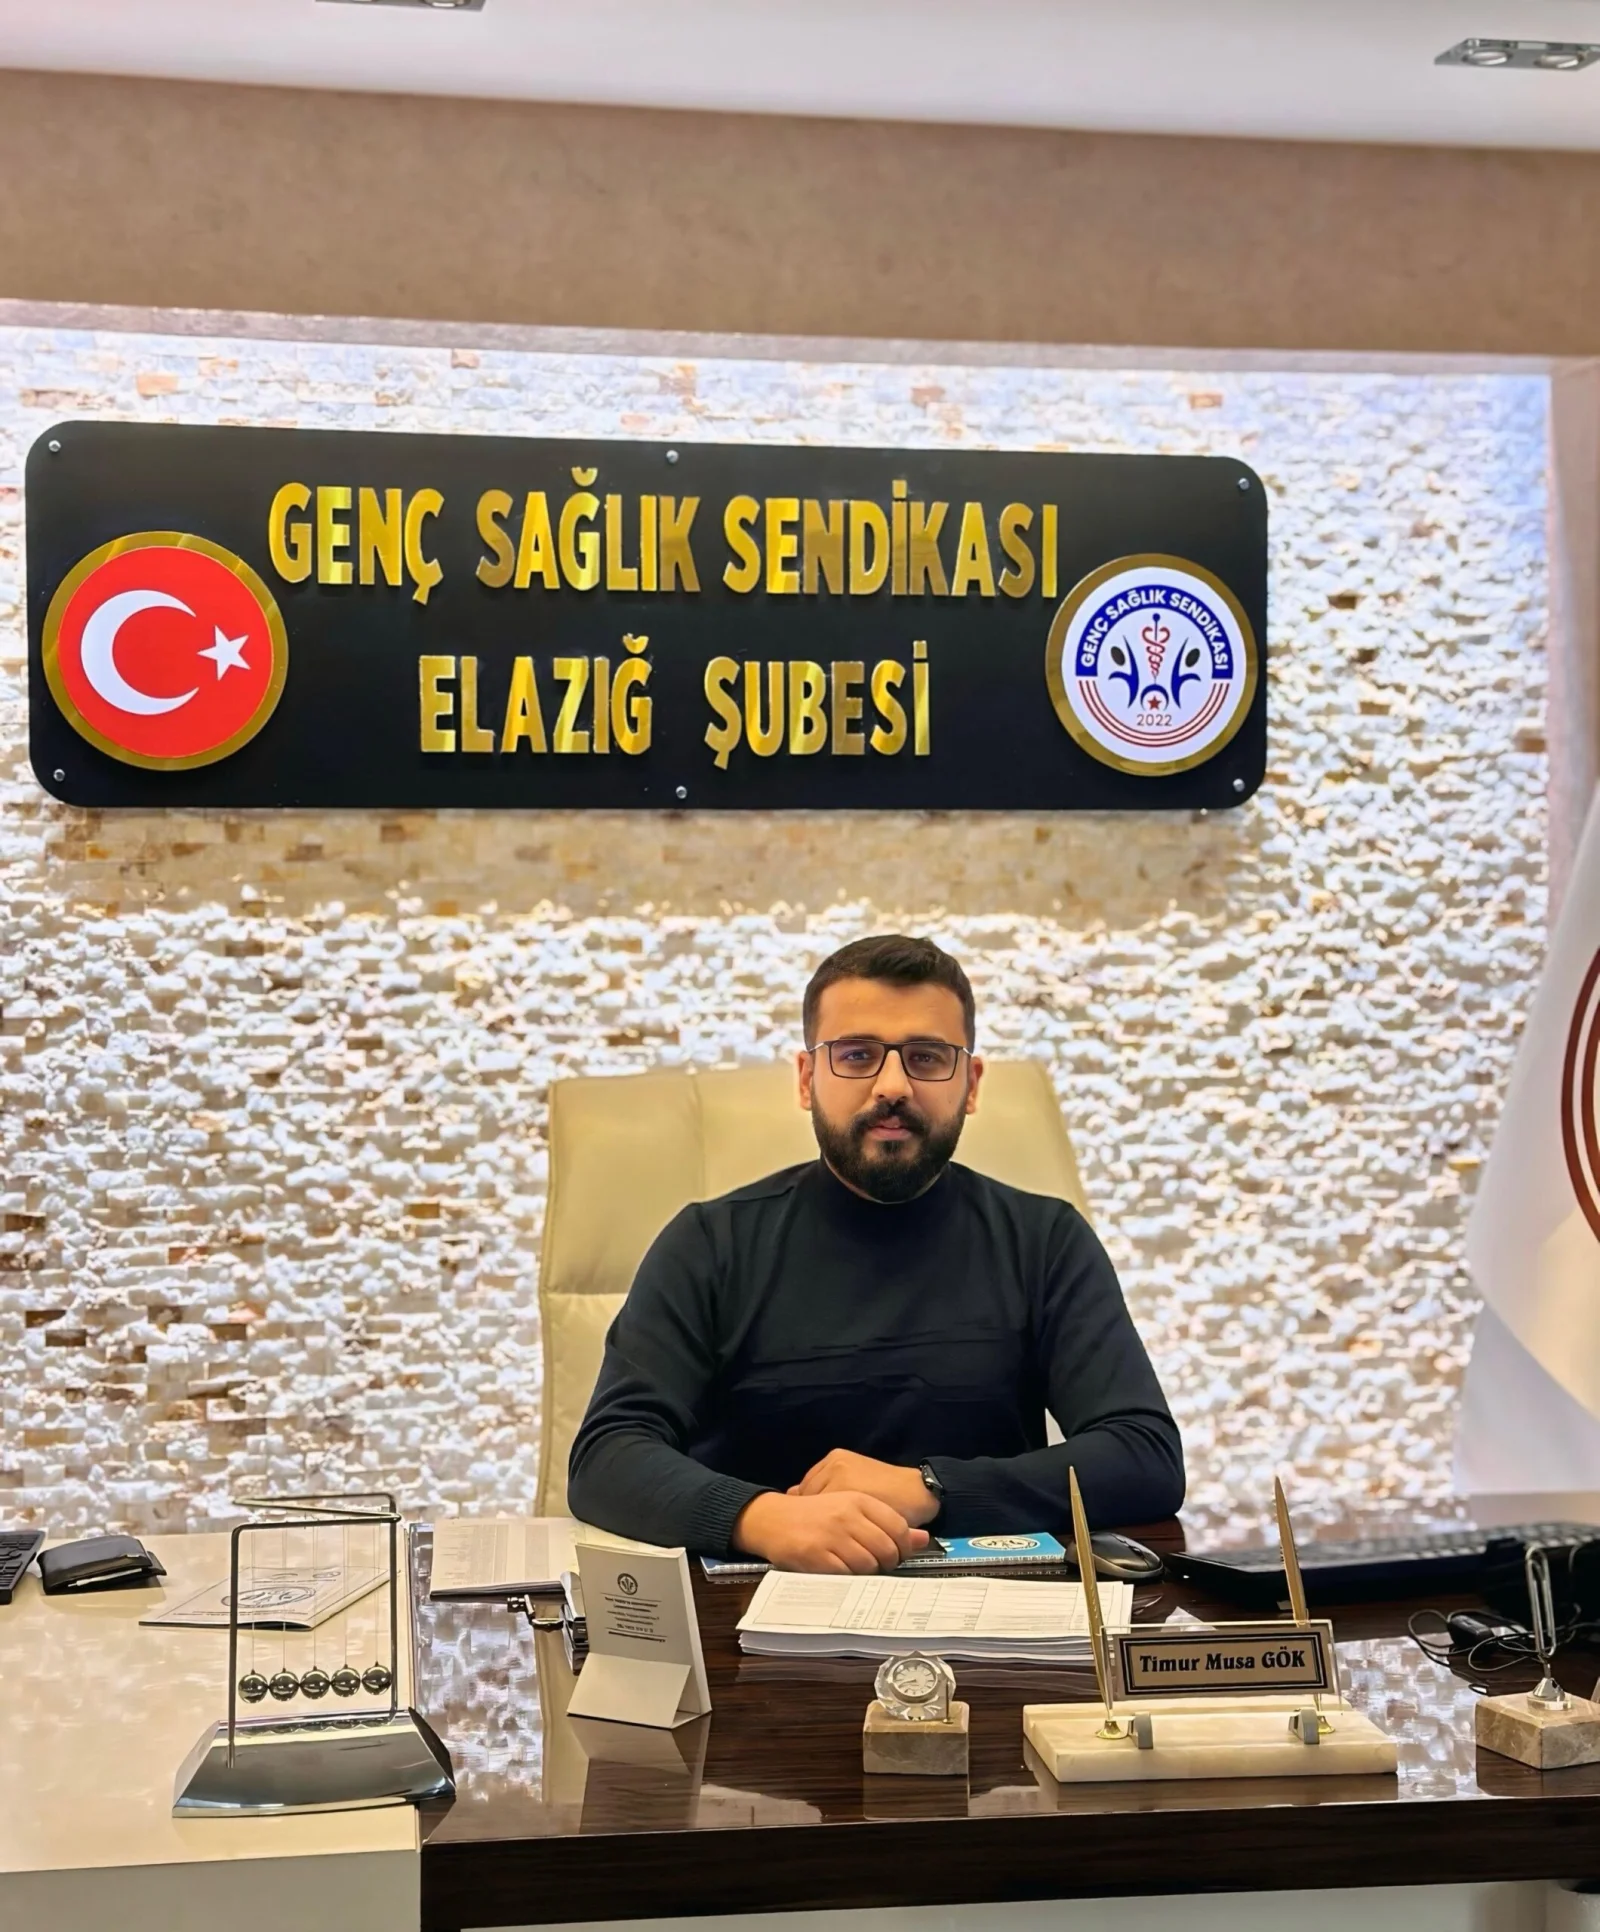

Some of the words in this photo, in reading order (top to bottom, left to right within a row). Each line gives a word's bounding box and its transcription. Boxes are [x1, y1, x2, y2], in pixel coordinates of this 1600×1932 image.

[269, 482, 445, 605] GENÇ
[475, 466, 701, 592] SAĞLIK
[723, 479, 1058, 598] SENDİKASI
[1081, 617, 1109, 667] GENÇ
[1105, 589, 1167, 620] SAĞLIK
[1169, 593, 1229, 670] SENDİKASI
[419, 633, 653, 755] ELAZIĞ
[704, 640, 930, 770] ŞUBESİ
[1136, 713, 1172, 727] 2022
[1139, 1655, 1200, 1672] Timur
[1205, 1653, 1255, 1670] Musa
[1261, 1646, 1306, 1669] GÖK
